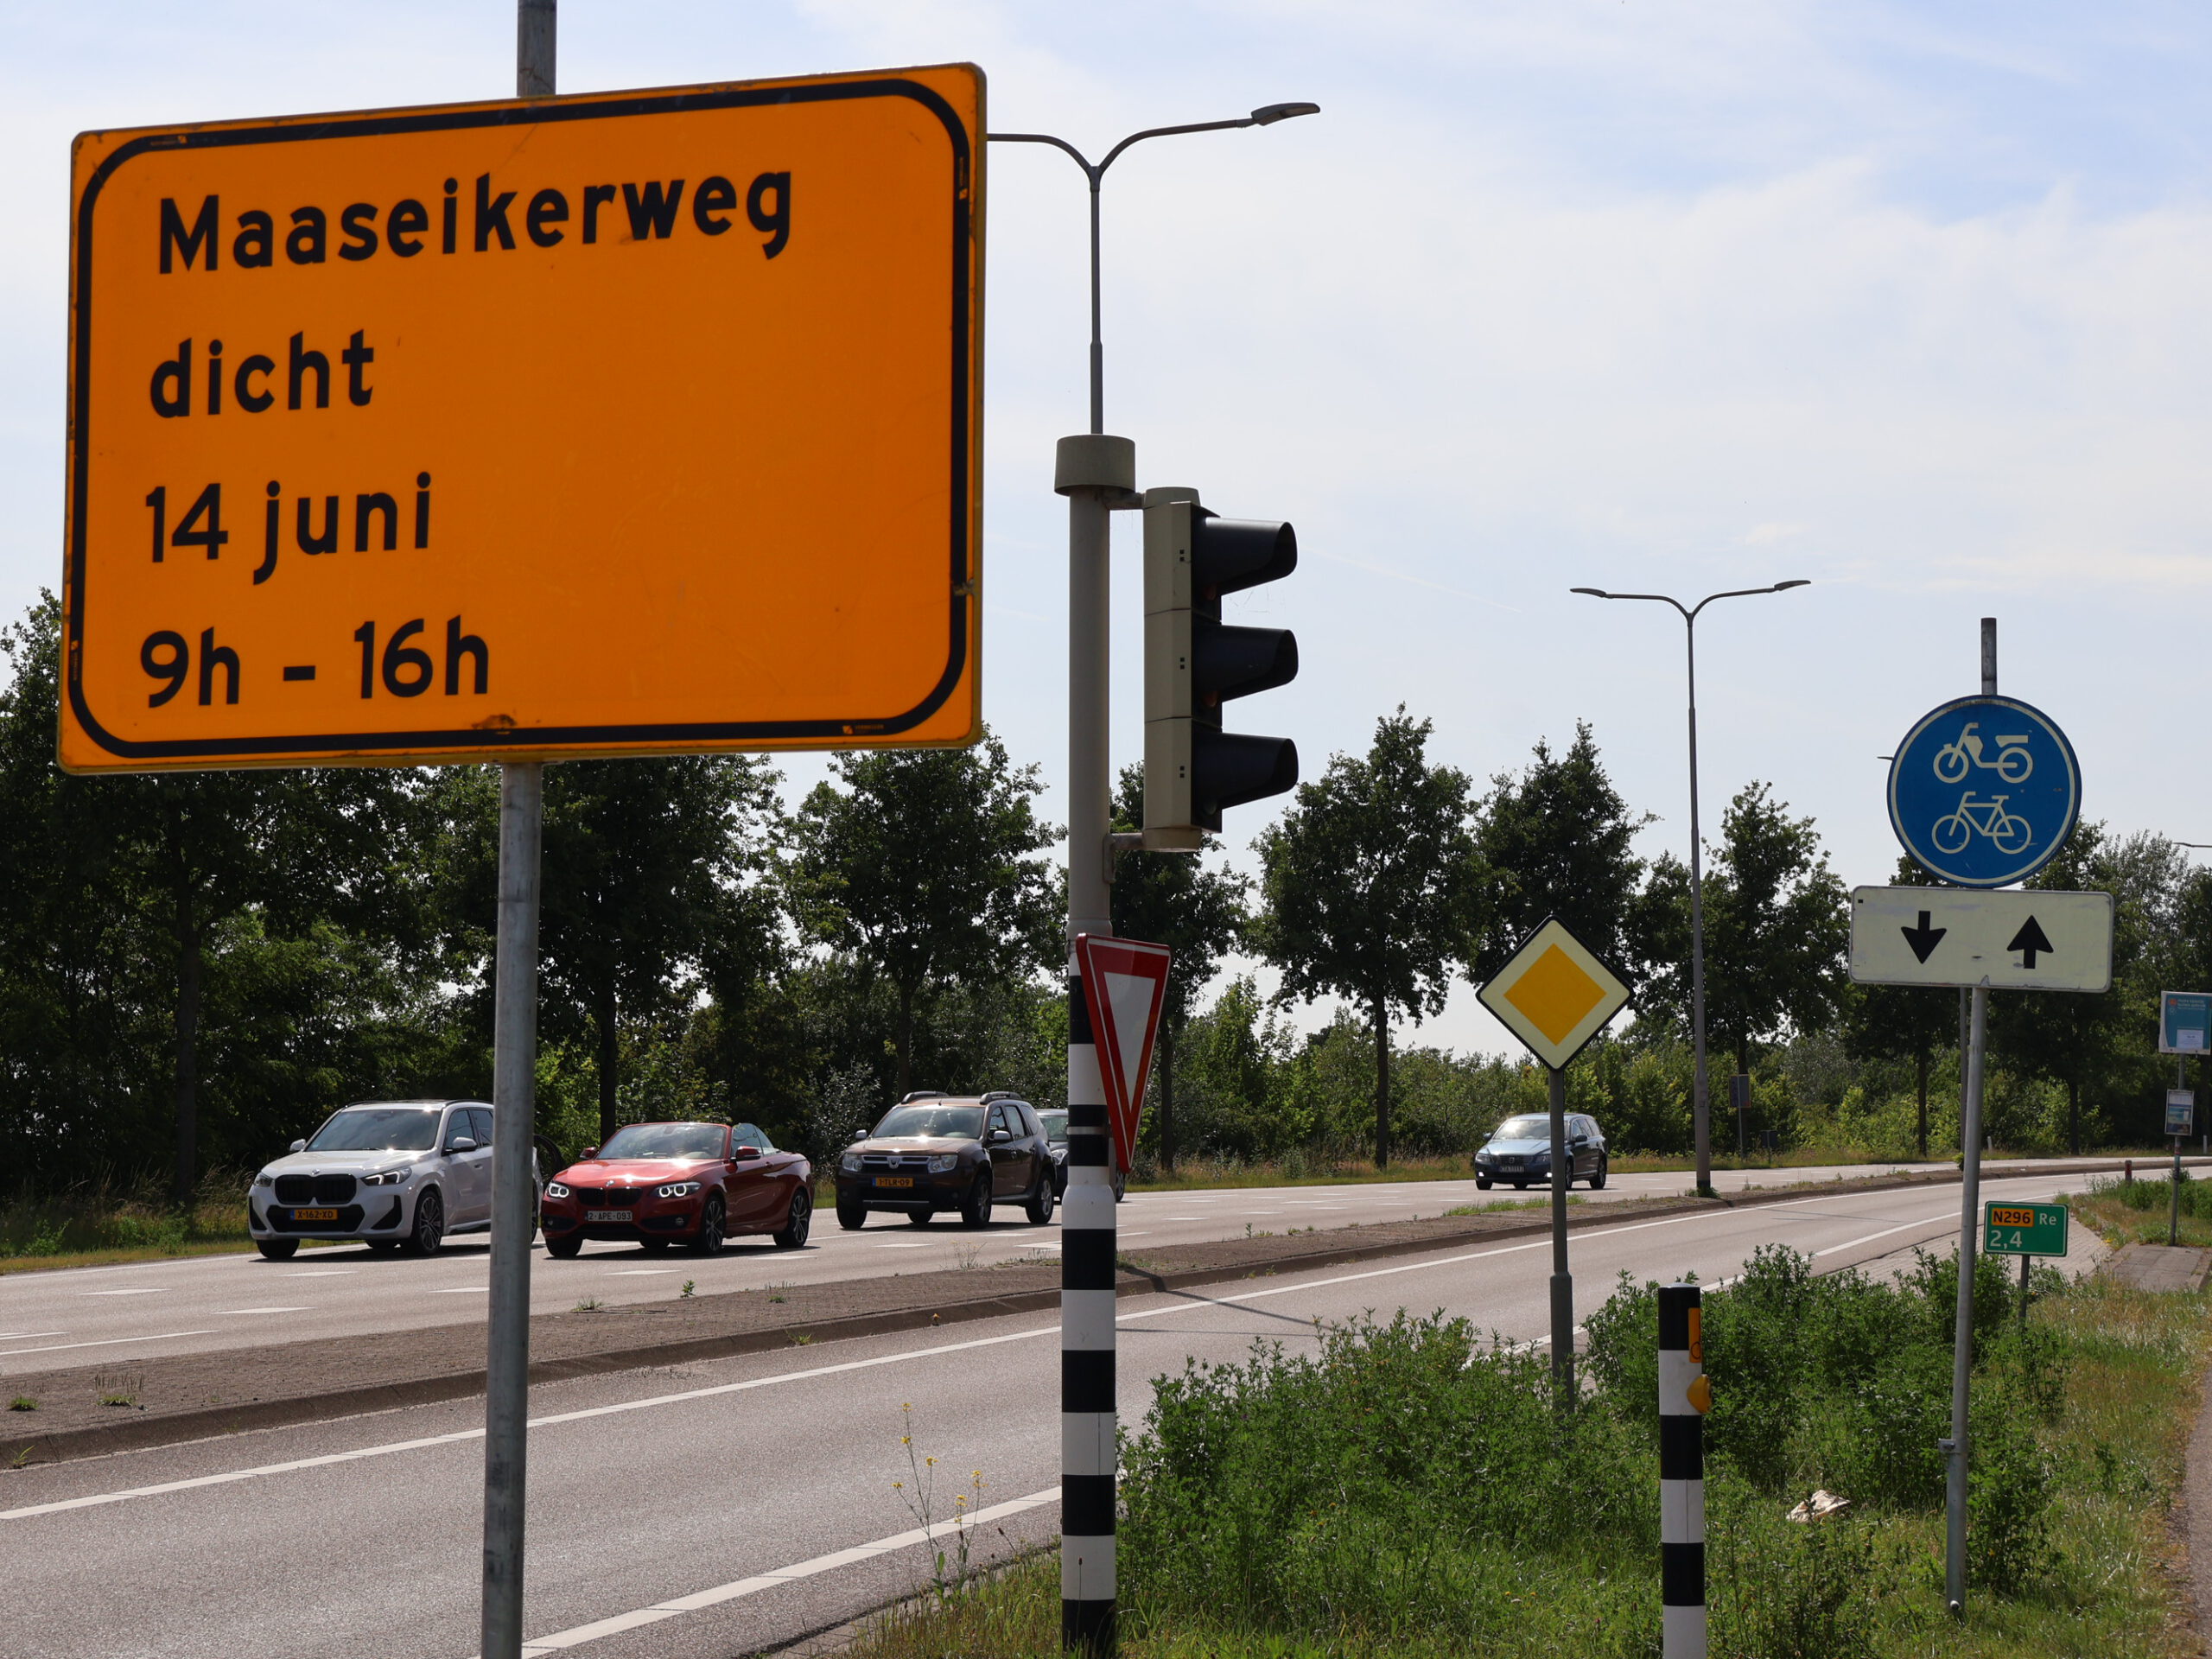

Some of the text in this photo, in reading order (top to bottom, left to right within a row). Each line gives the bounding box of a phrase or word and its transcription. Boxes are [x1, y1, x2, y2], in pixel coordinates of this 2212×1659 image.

[160, 171, 791, 274] Maaseikerweg
[150, 329, 374, 418] dicht
[146, 472, 431, 585] 14 juni
[141, 626, 240, 708] 9h
[354, 615, 489, 699] 16h
[588, 1211, 632, 1221] 2-APE-093
[1990, 1230, 2023, 1249] 2,4
[1993, 1211, 2057, 1225] N296 Re
